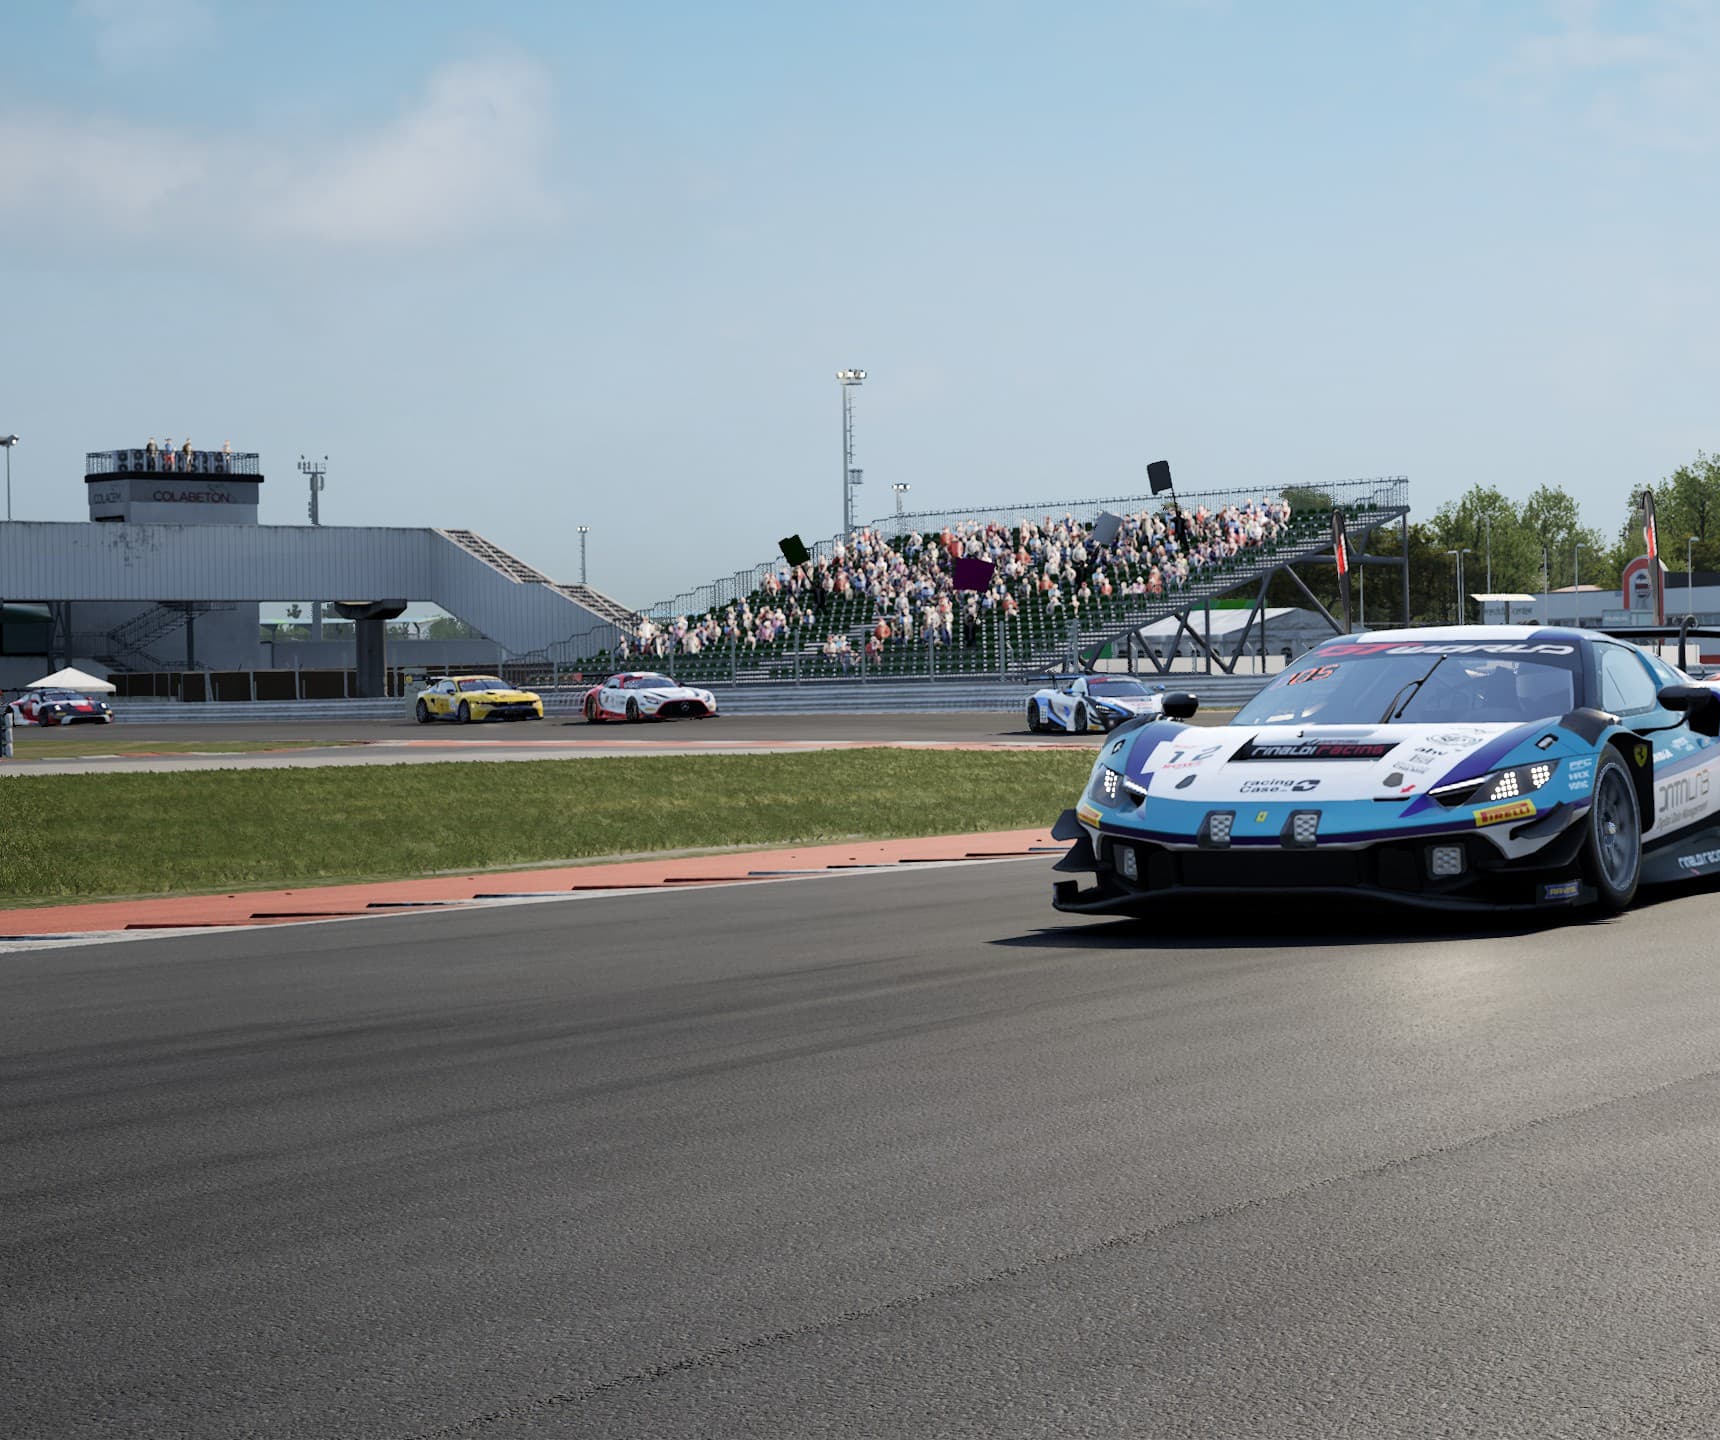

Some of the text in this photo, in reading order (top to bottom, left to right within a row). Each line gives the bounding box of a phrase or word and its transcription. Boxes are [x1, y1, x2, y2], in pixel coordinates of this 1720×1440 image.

[153, 490, 231, 503] COLABETON
[1384, 645, 1575, 656] WORLD
[1243, 778, 1295, 787] racing
[1480, 802, 1531, 823] PIRELLI
